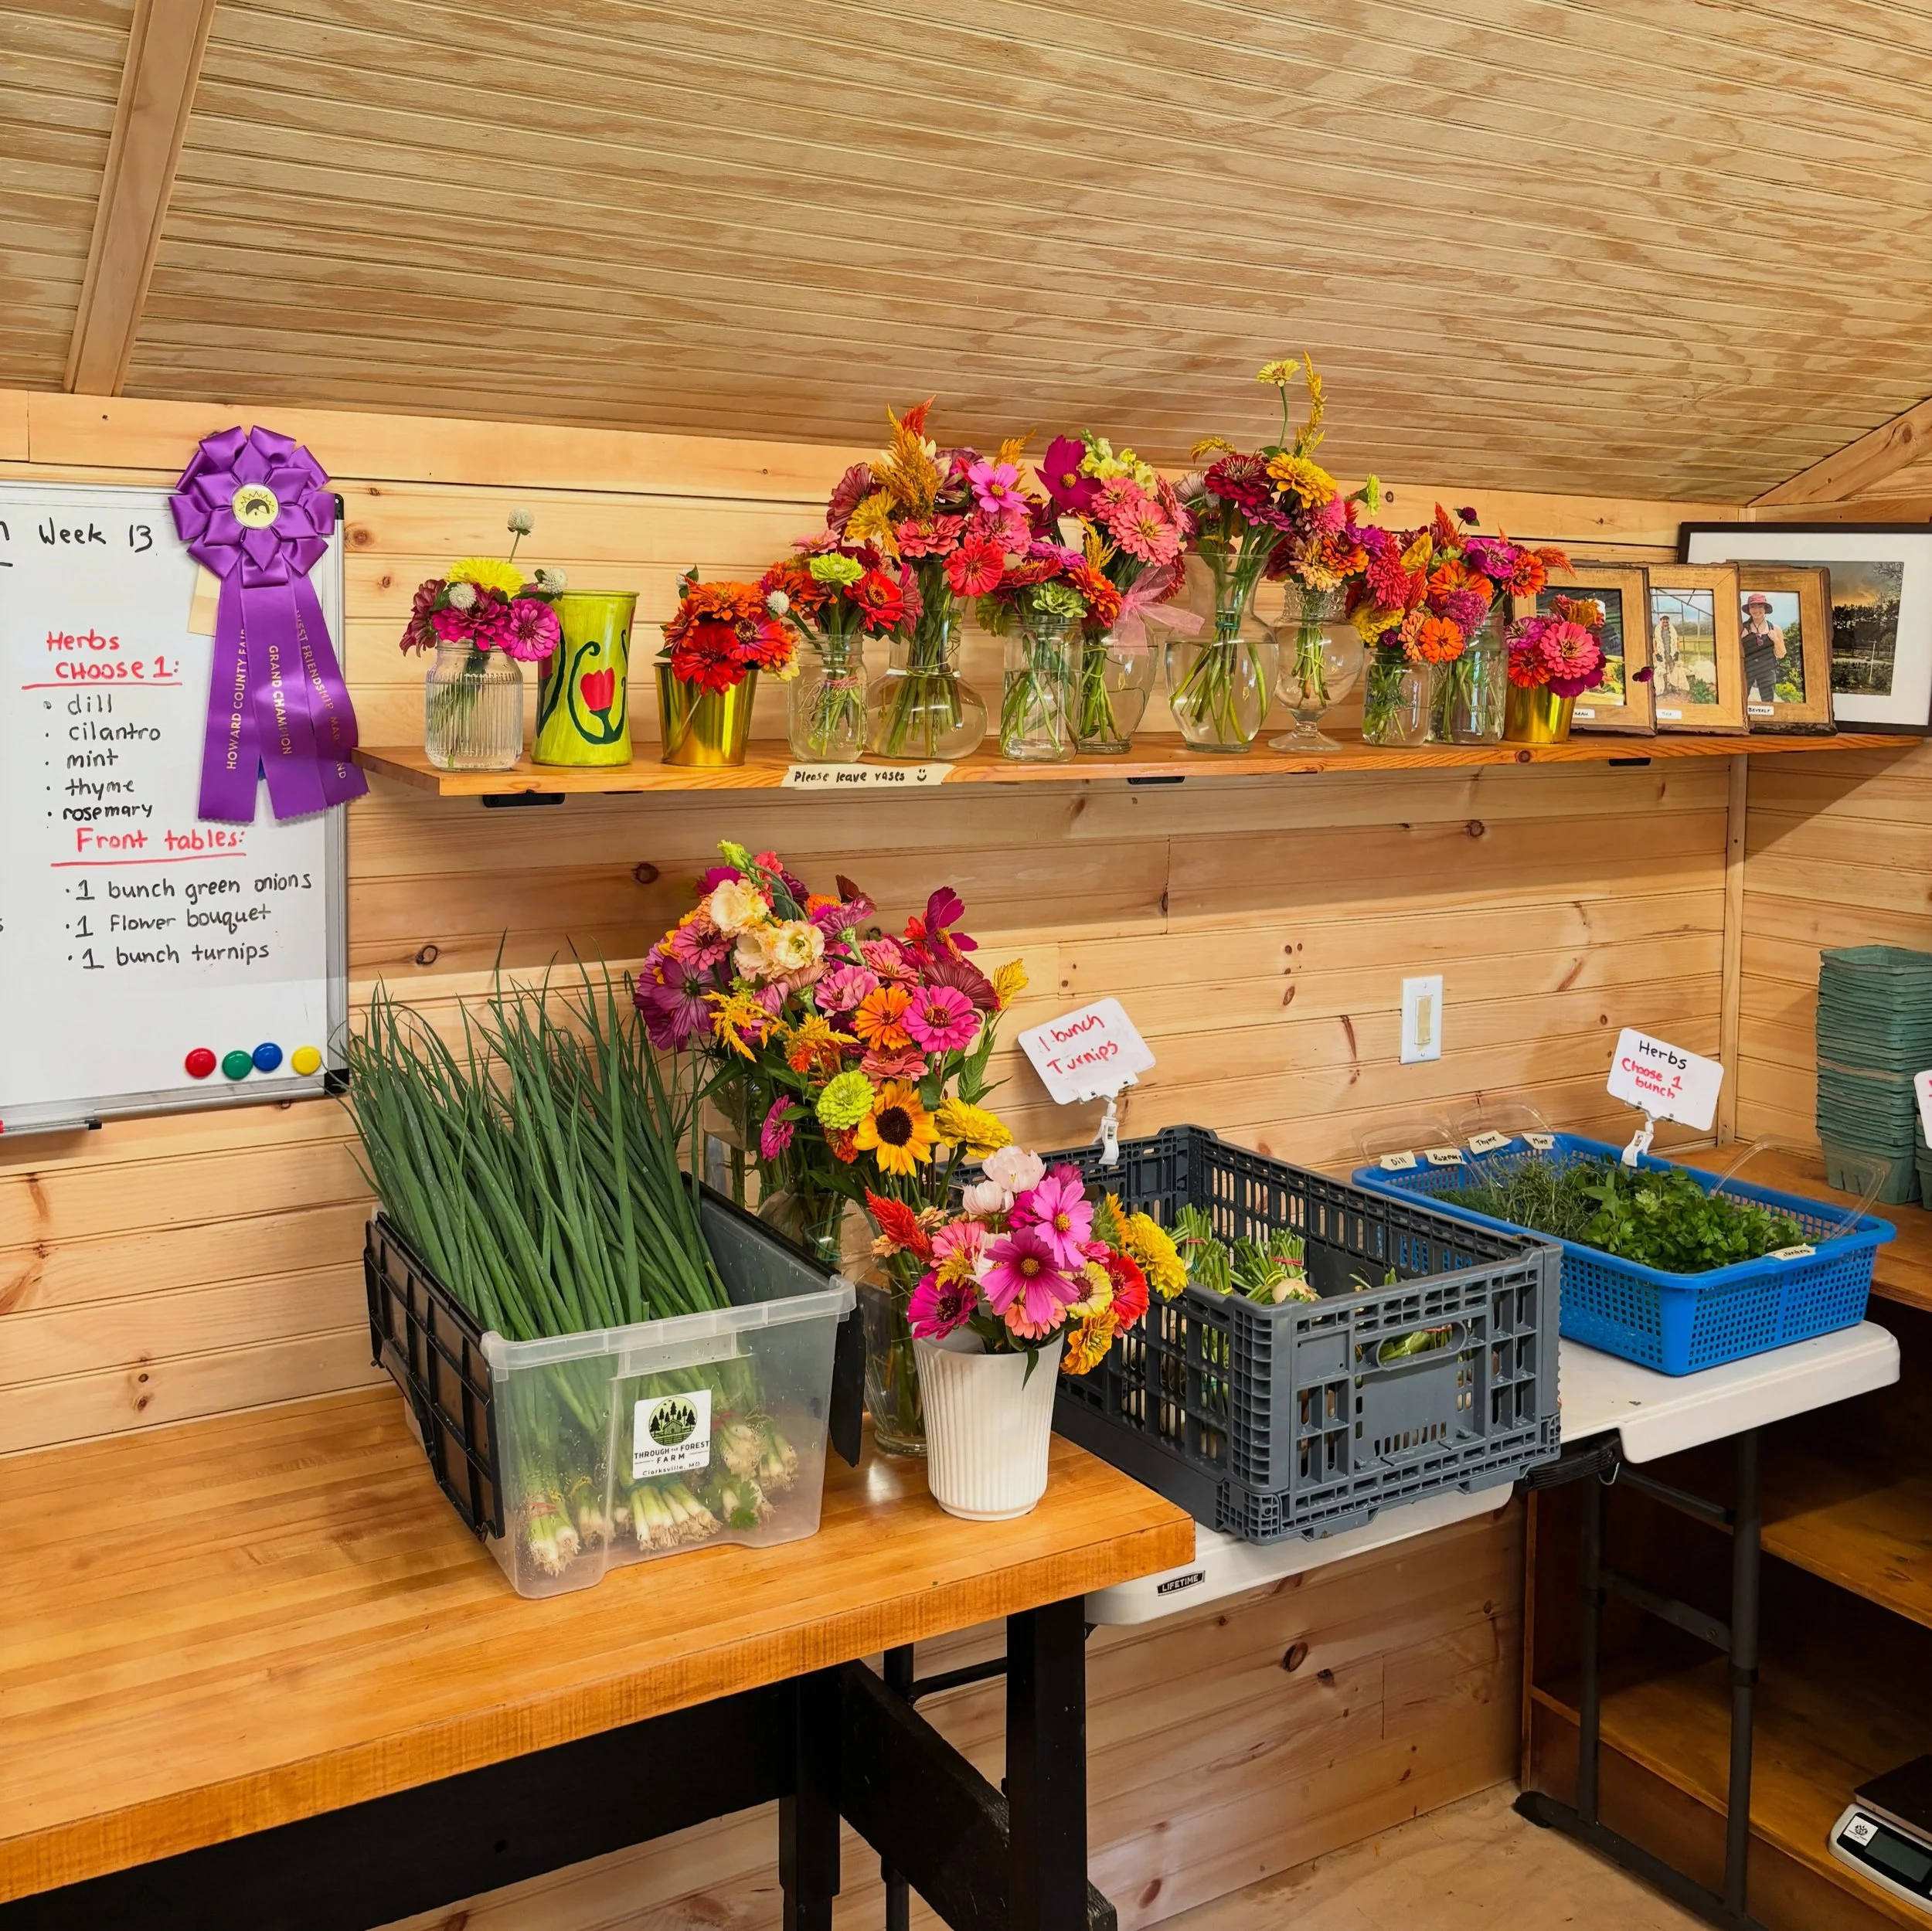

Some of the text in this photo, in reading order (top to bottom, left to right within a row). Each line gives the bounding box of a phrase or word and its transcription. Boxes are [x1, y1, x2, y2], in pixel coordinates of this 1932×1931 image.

[39, 517, 106, 545] Week
[129, 525, 152, 552] 13
[47, 629, 119, 651] Herbs
[233, 658, 247, 709] COUNTY
[68, 694, 111, 715] dill
[269, 645, 292, 754] GRAND CHAMPION
[301, 644, 334, 709] FRIENDSHIP
[330, 716, 346, 779] MARND
[70, 722, 160, 740] cilantro
[226, 713, 243, 770] HOWARD
[67, 748, 118, 768] mint
[794, 771, 904, 782] Please leave vases
[65, 777, 135, 801] thyme
[63, 801, 153, 821] rosemary
[77, 828, 247, 852] Front tables:
[76, 874, 311, 905] 1 bunch green onions
[76, 903, 271, 937] 1 Flower bouquet
[83, 943, 270, 969] 1 bunch turnips
[1050, 1014, 1105, 1042] bunch
[1046, 1040, 1118, 1074] Turnips
[1638, 1040, 1688, 1069] Herbs
[1621, 1057, 1683, 1090] Choose 1
[1635, 1076, 1676, 1099] bunch
[1475, 1136, 1497, 1147] Thyme
[1390, 1157, 1407, 1166] Dill
[1433, 1154, 1463, 1163] Rosemary
[634, 1448, 669, 1460] THROUGH
[680, 1440, 710, 1451] FOREST
[657, 1453, 685, 1464] FARM
[1162, 1575, 1199, 1592] LIFETIME
